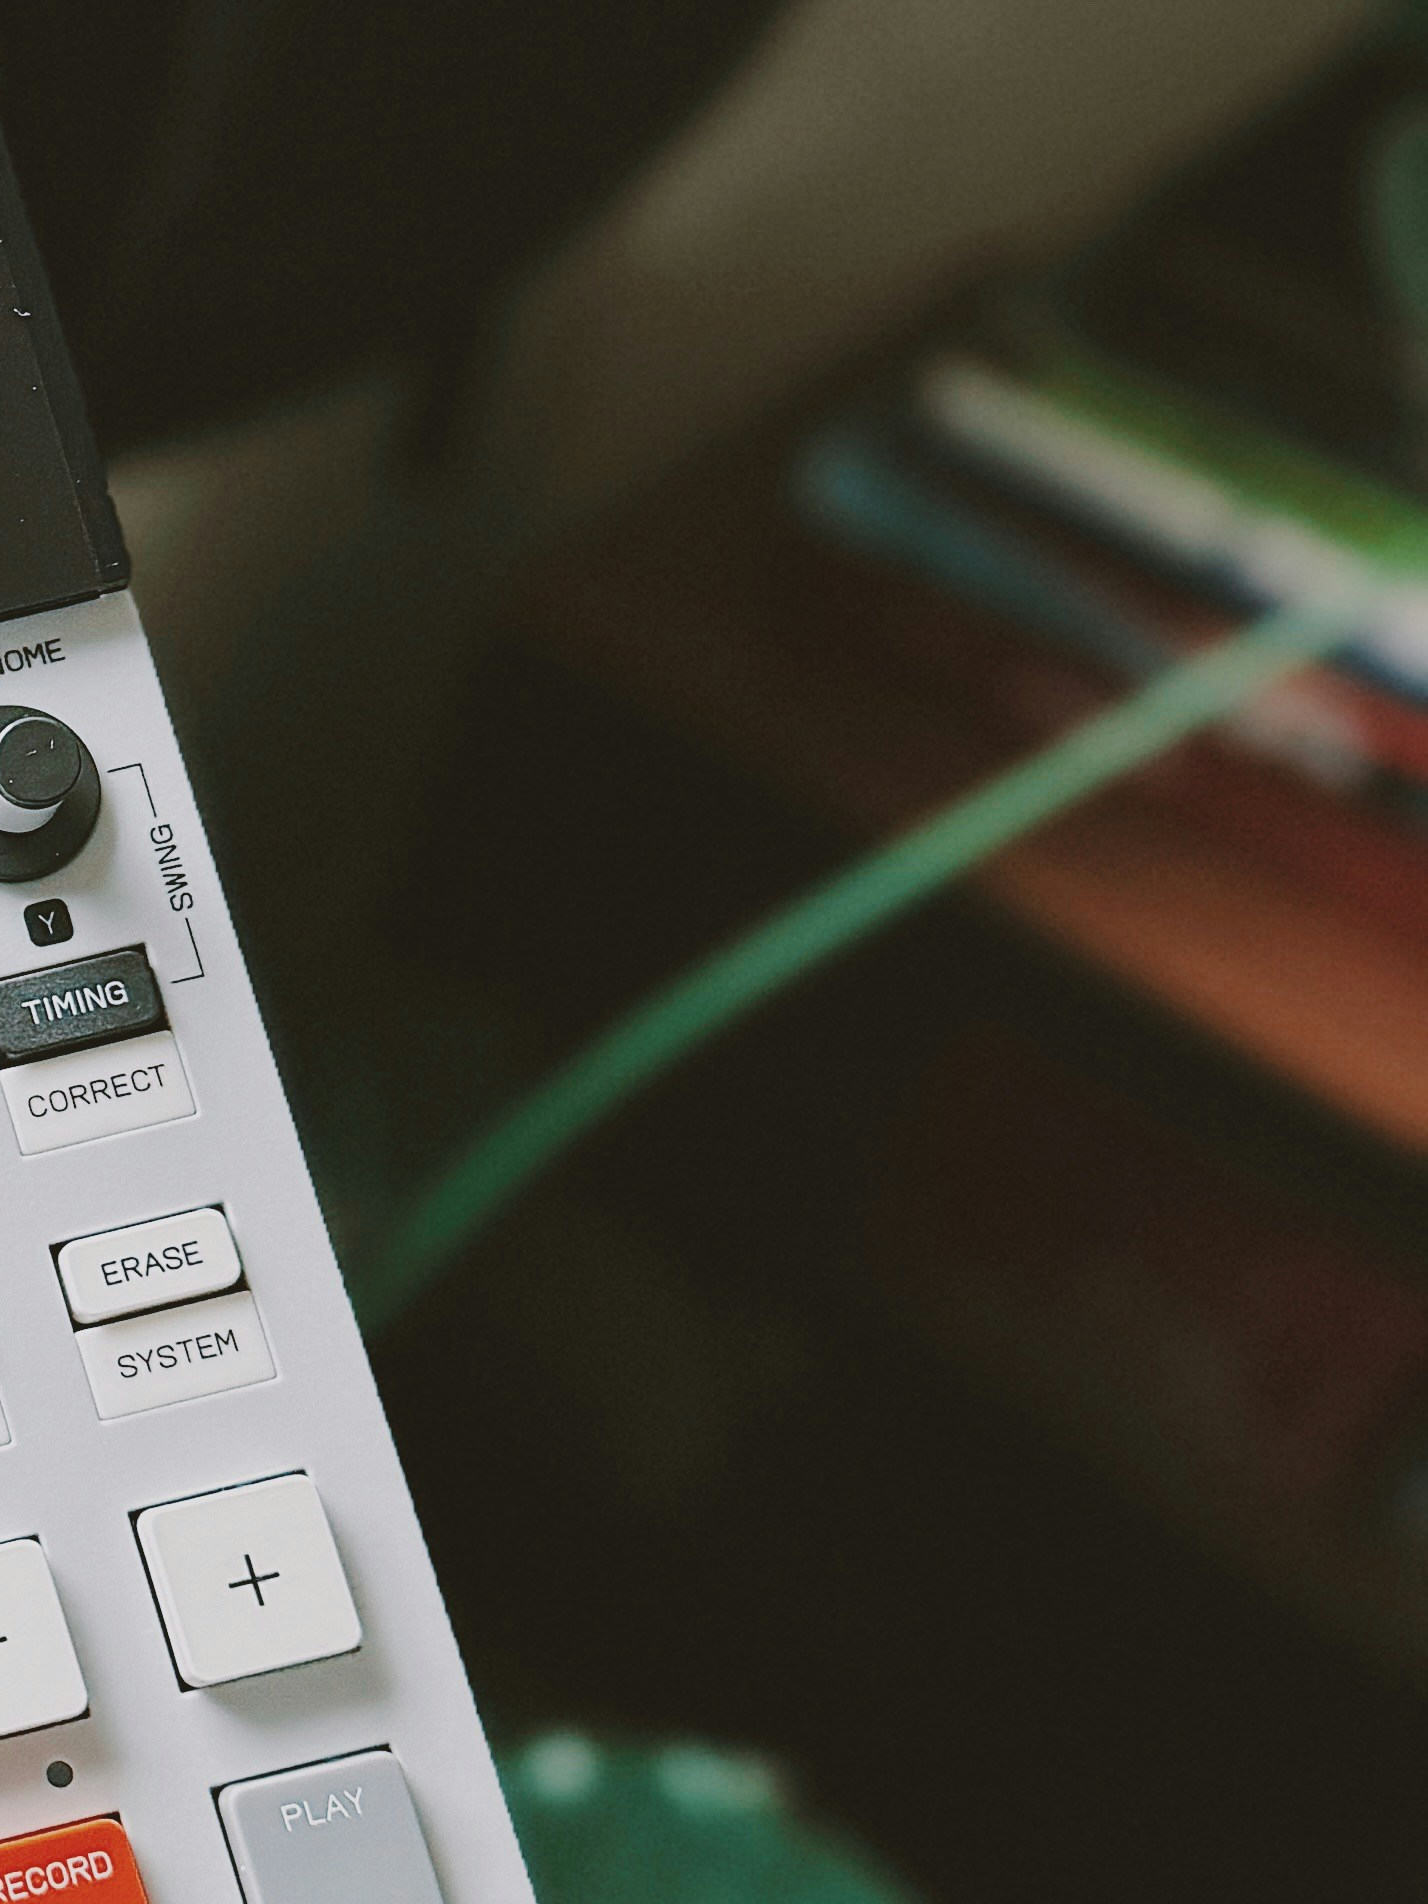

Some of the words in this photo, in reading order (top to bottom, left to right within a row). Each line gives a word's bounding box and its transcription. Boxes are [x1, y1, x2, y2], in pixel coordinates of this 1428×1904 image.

[149, 823, 195, 913] SWING
[37, 913, 59, 936] Y
[21, 980, 129, 1026] TIMING
[28, 1063, 167, 1118] CORRECT
[101, 1240, 203, 1287] ERASE
[116, 1328, 240, 1379] SYSTEM
[280, 1786, 365, 1833] PLAY
